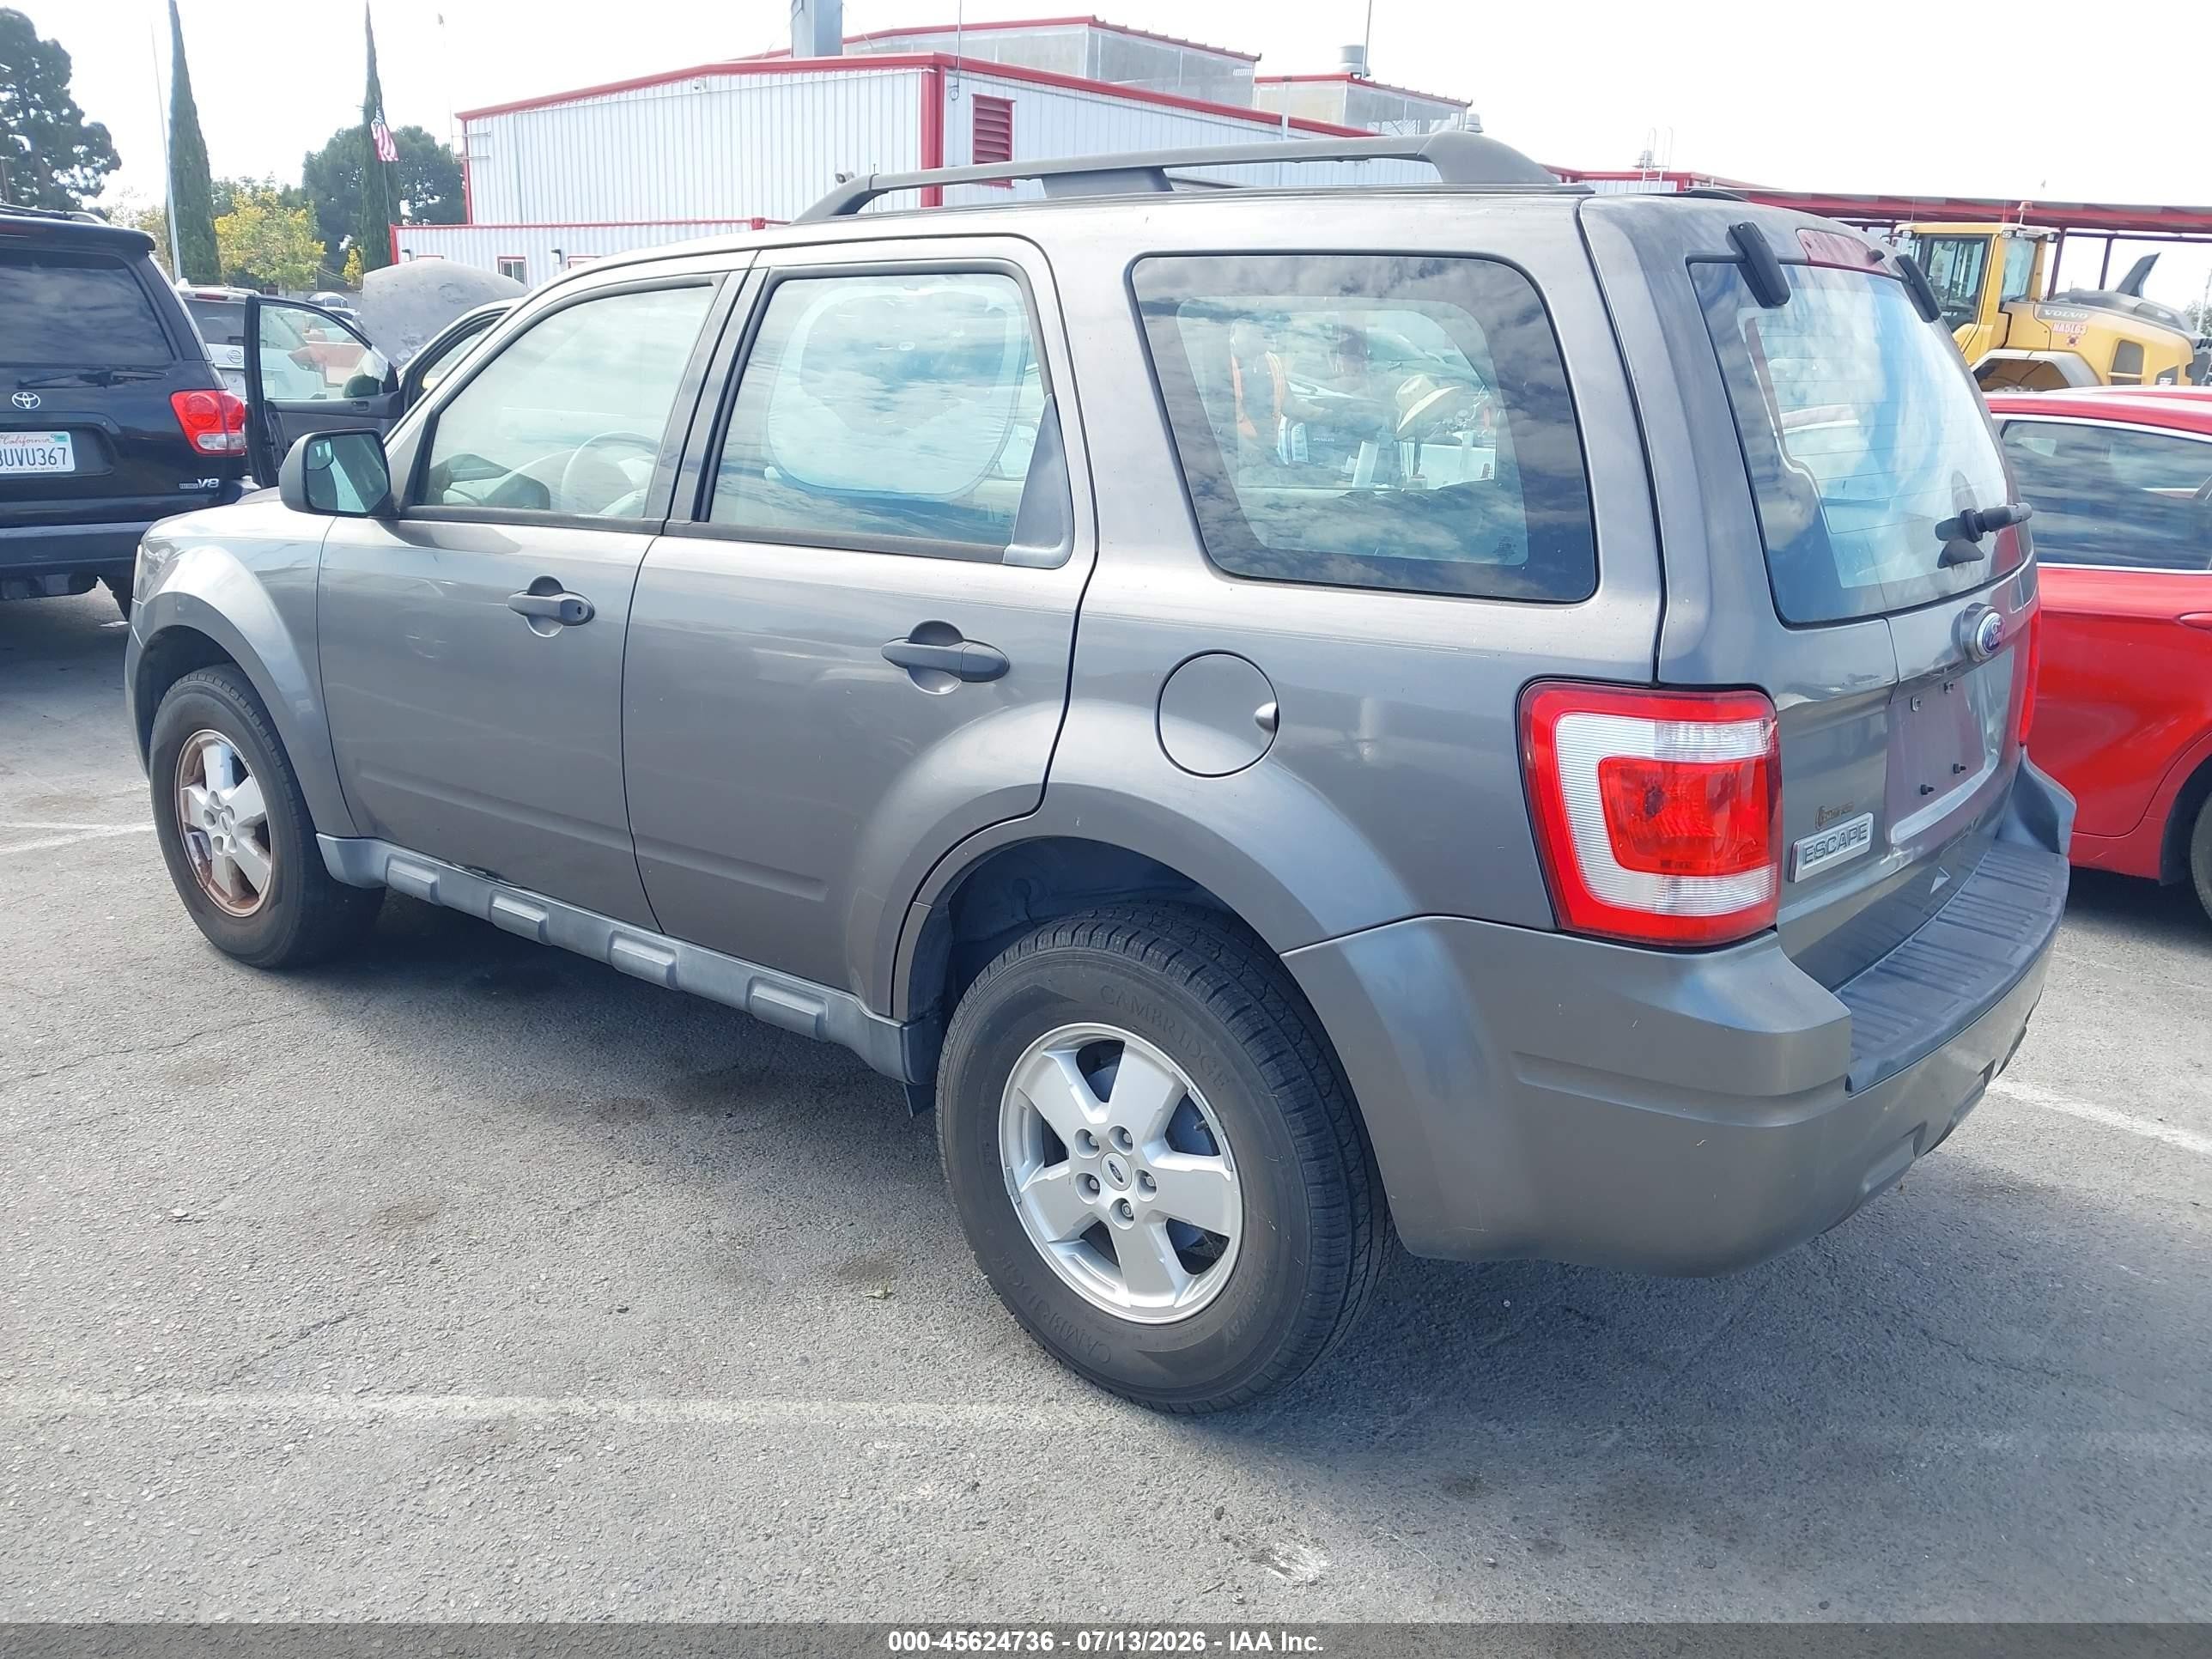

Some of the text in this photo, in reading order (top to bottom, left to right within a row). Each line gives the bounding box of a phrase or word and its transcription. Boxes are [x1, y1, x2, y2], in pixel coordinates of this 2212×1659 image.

[2045, 309, 2088, 319] VOLVO
[3, 434, 51, 447] California
[197, 477, 220, 489] V8
[1804, 823, 1868, 866] ESCAPE
[1100, 985, 1231, 1091] CAMBRIDGE
